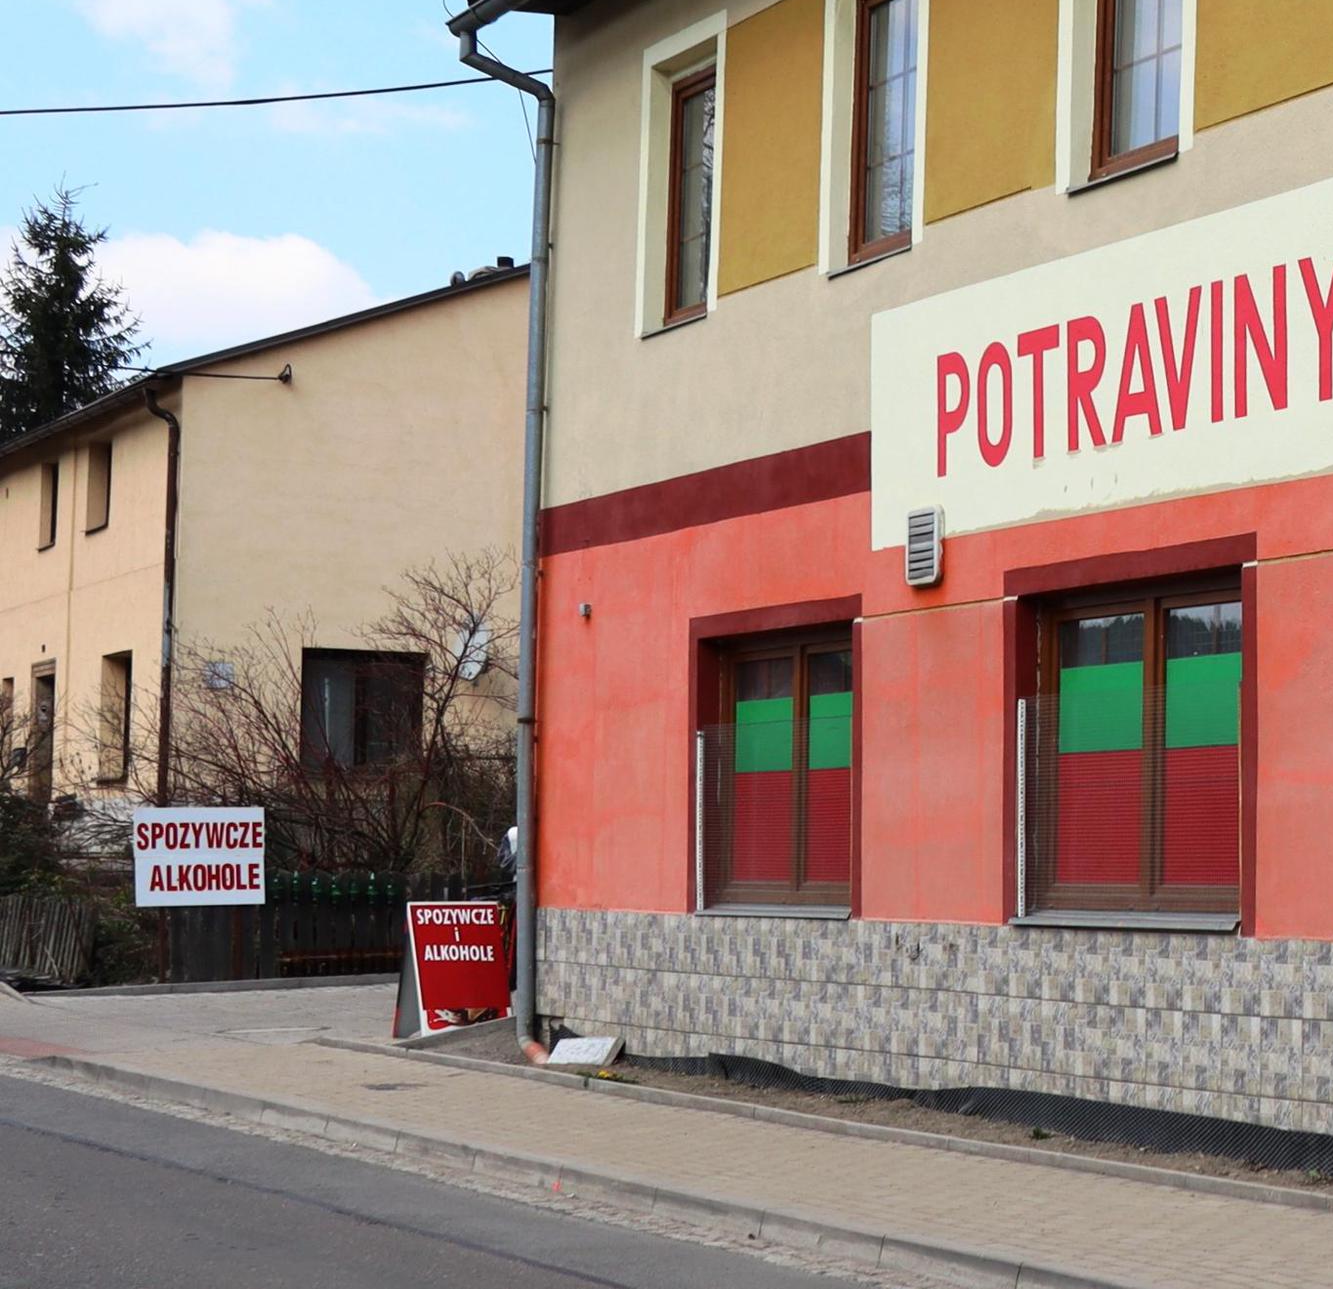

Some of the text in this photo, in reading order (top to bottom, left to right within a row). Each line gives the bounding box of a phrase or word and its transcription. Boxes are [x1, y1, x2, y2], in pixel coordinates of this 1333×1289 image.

[136, 822, 263, 850] SPOZYWCZE
[150, 862, 260, 892] ALKOHOLE
[416, 909, 494, 925] SPOZYWCZE
[454, 926, 460, 942] i
[424, 944, 494, 962] ALKOHOLE
